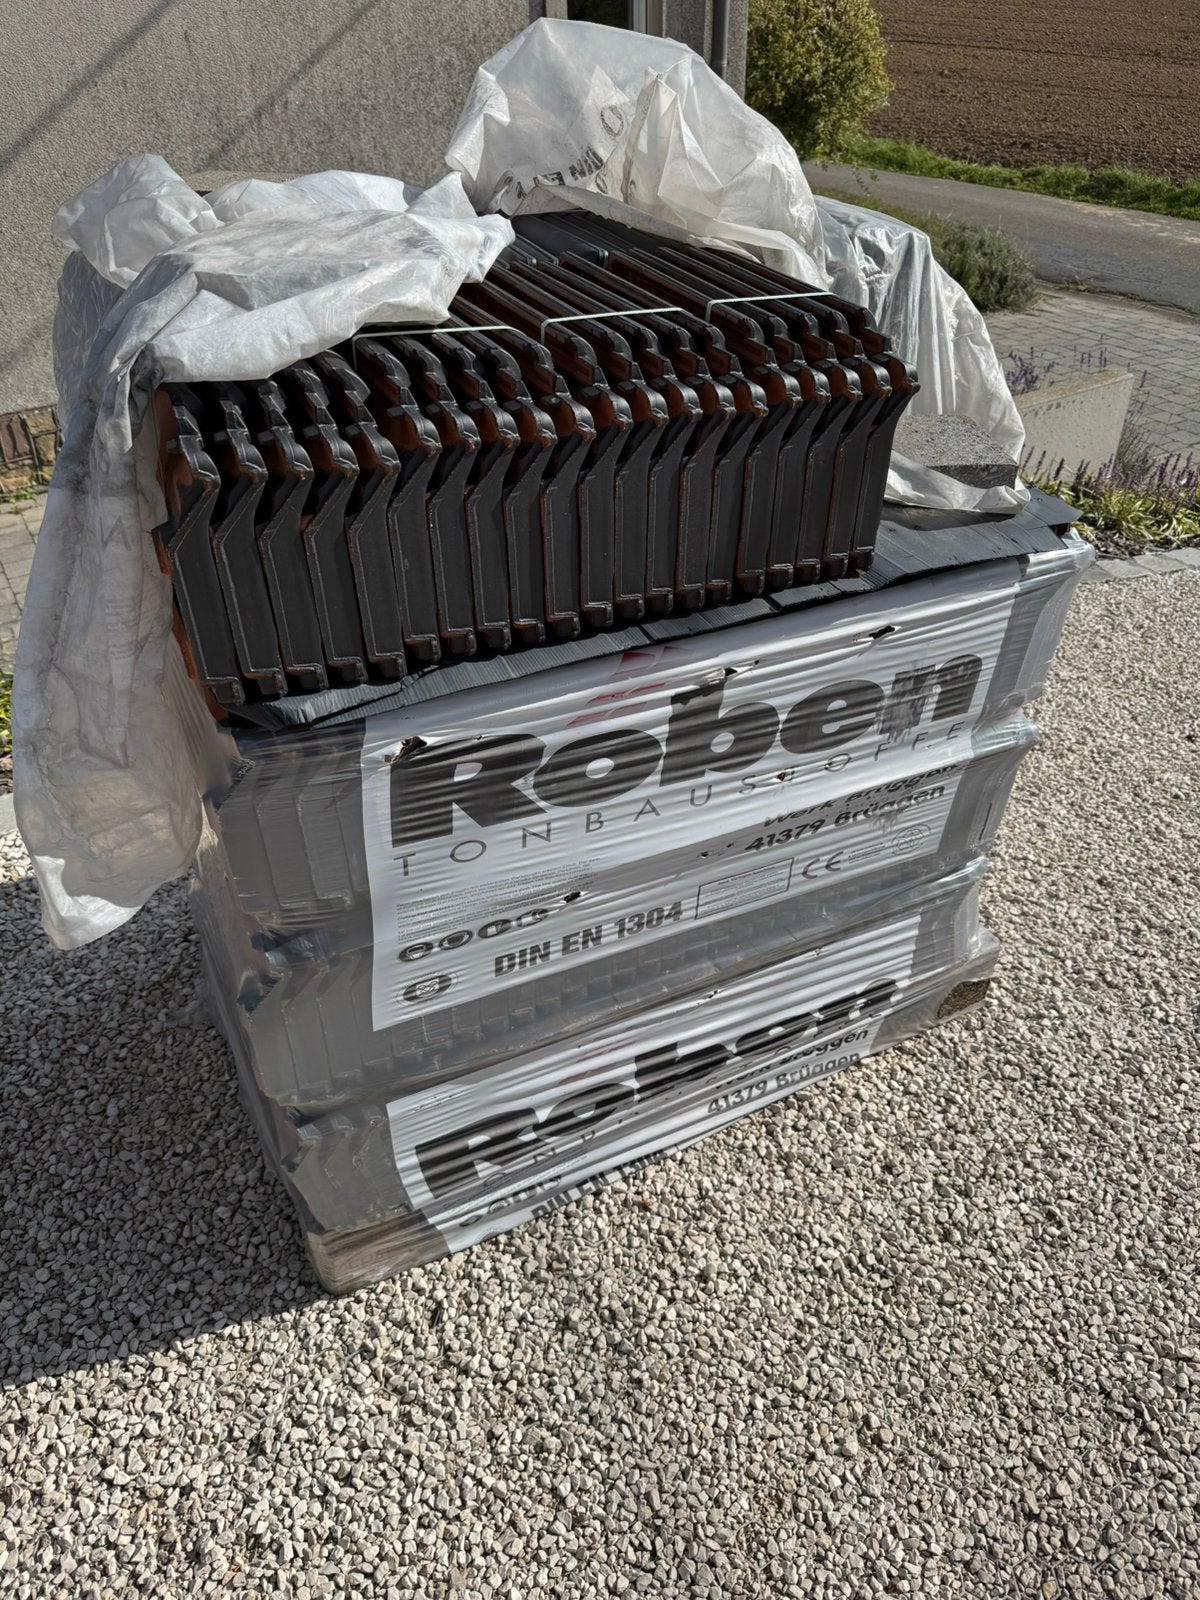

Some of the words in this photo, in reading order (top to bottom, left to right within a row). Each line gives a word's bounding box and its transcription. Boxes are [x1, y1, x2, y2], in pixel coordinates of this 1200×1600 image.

[744, 819, 826, 851] 41379
[494, 940, 551, 977] DIN
[561, 924, 602, 956] EN
[614, 901, 683, 939] 1304
[707, 1080, 768, 1114] 41379
